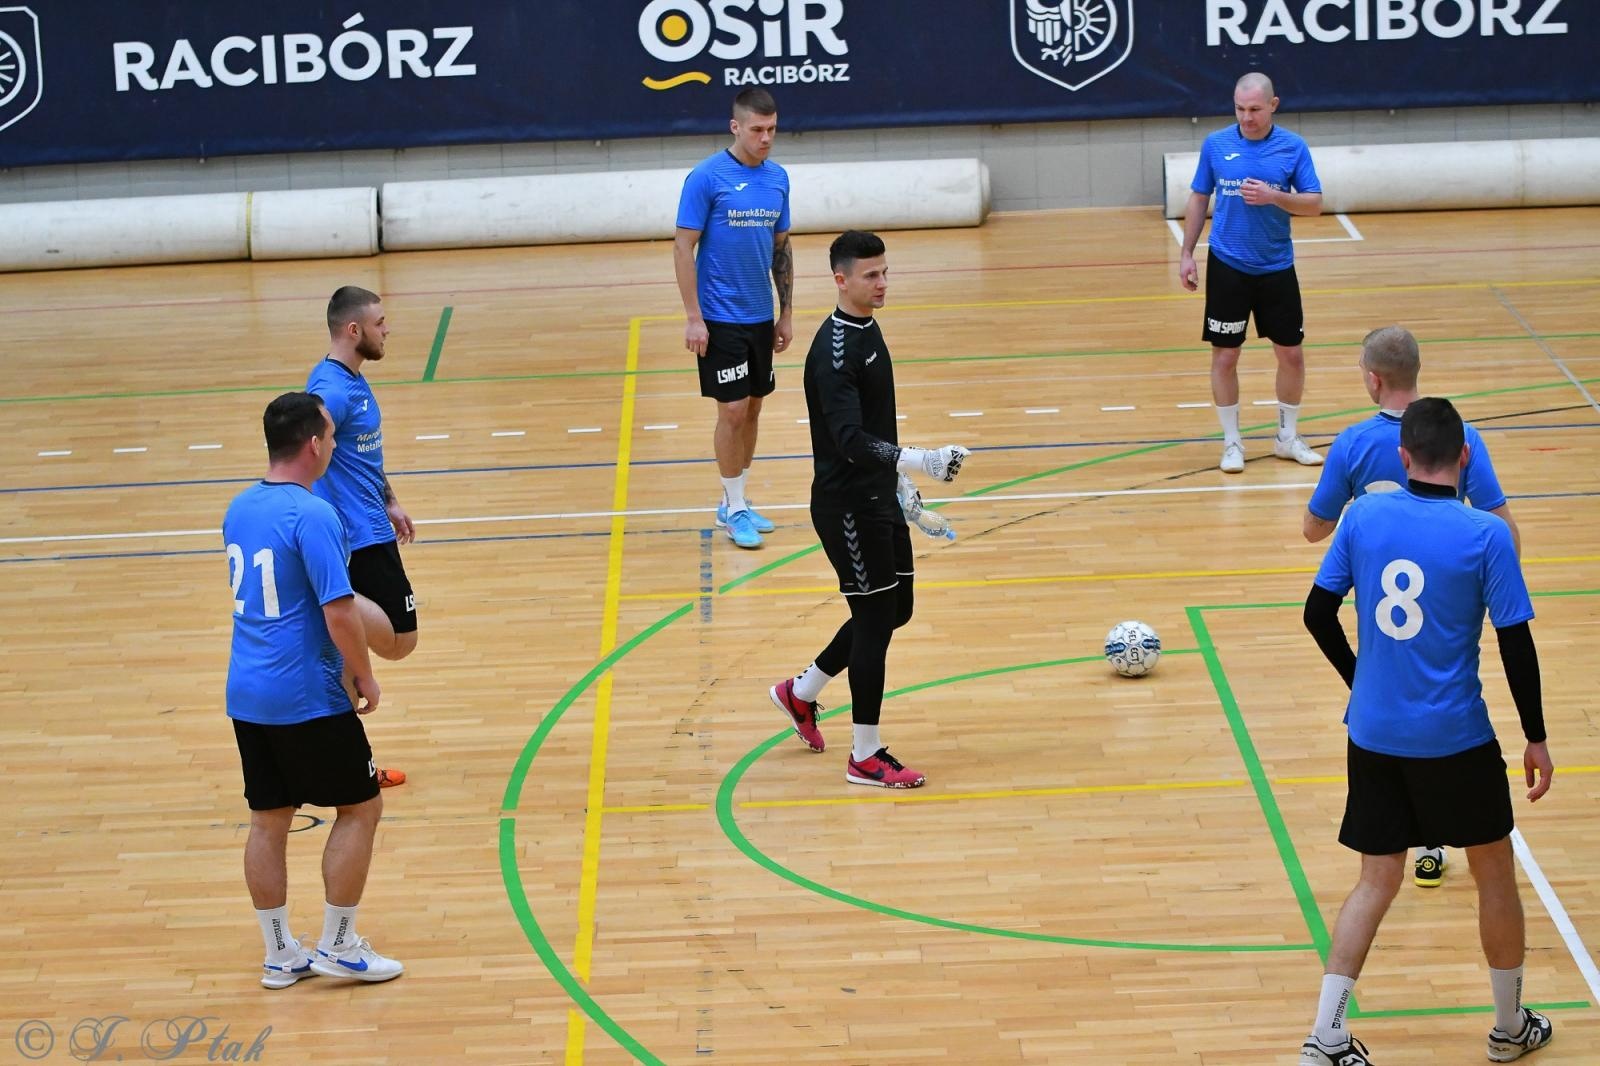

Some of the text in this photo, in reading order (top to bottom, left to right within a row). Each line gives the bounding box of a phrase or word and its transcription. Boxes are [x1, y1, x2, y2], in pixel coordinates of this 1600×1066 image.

[113, 12, 477, 92] RACIBÓRZ
[638, 0, 849, 62] OSiR
[724, 59, 850, 86] RACIBÓRZ
[717, 366, 737, 384] LSM
[226, 542, 280, 618] 21
[1375, 558, 1425, 641] 8
